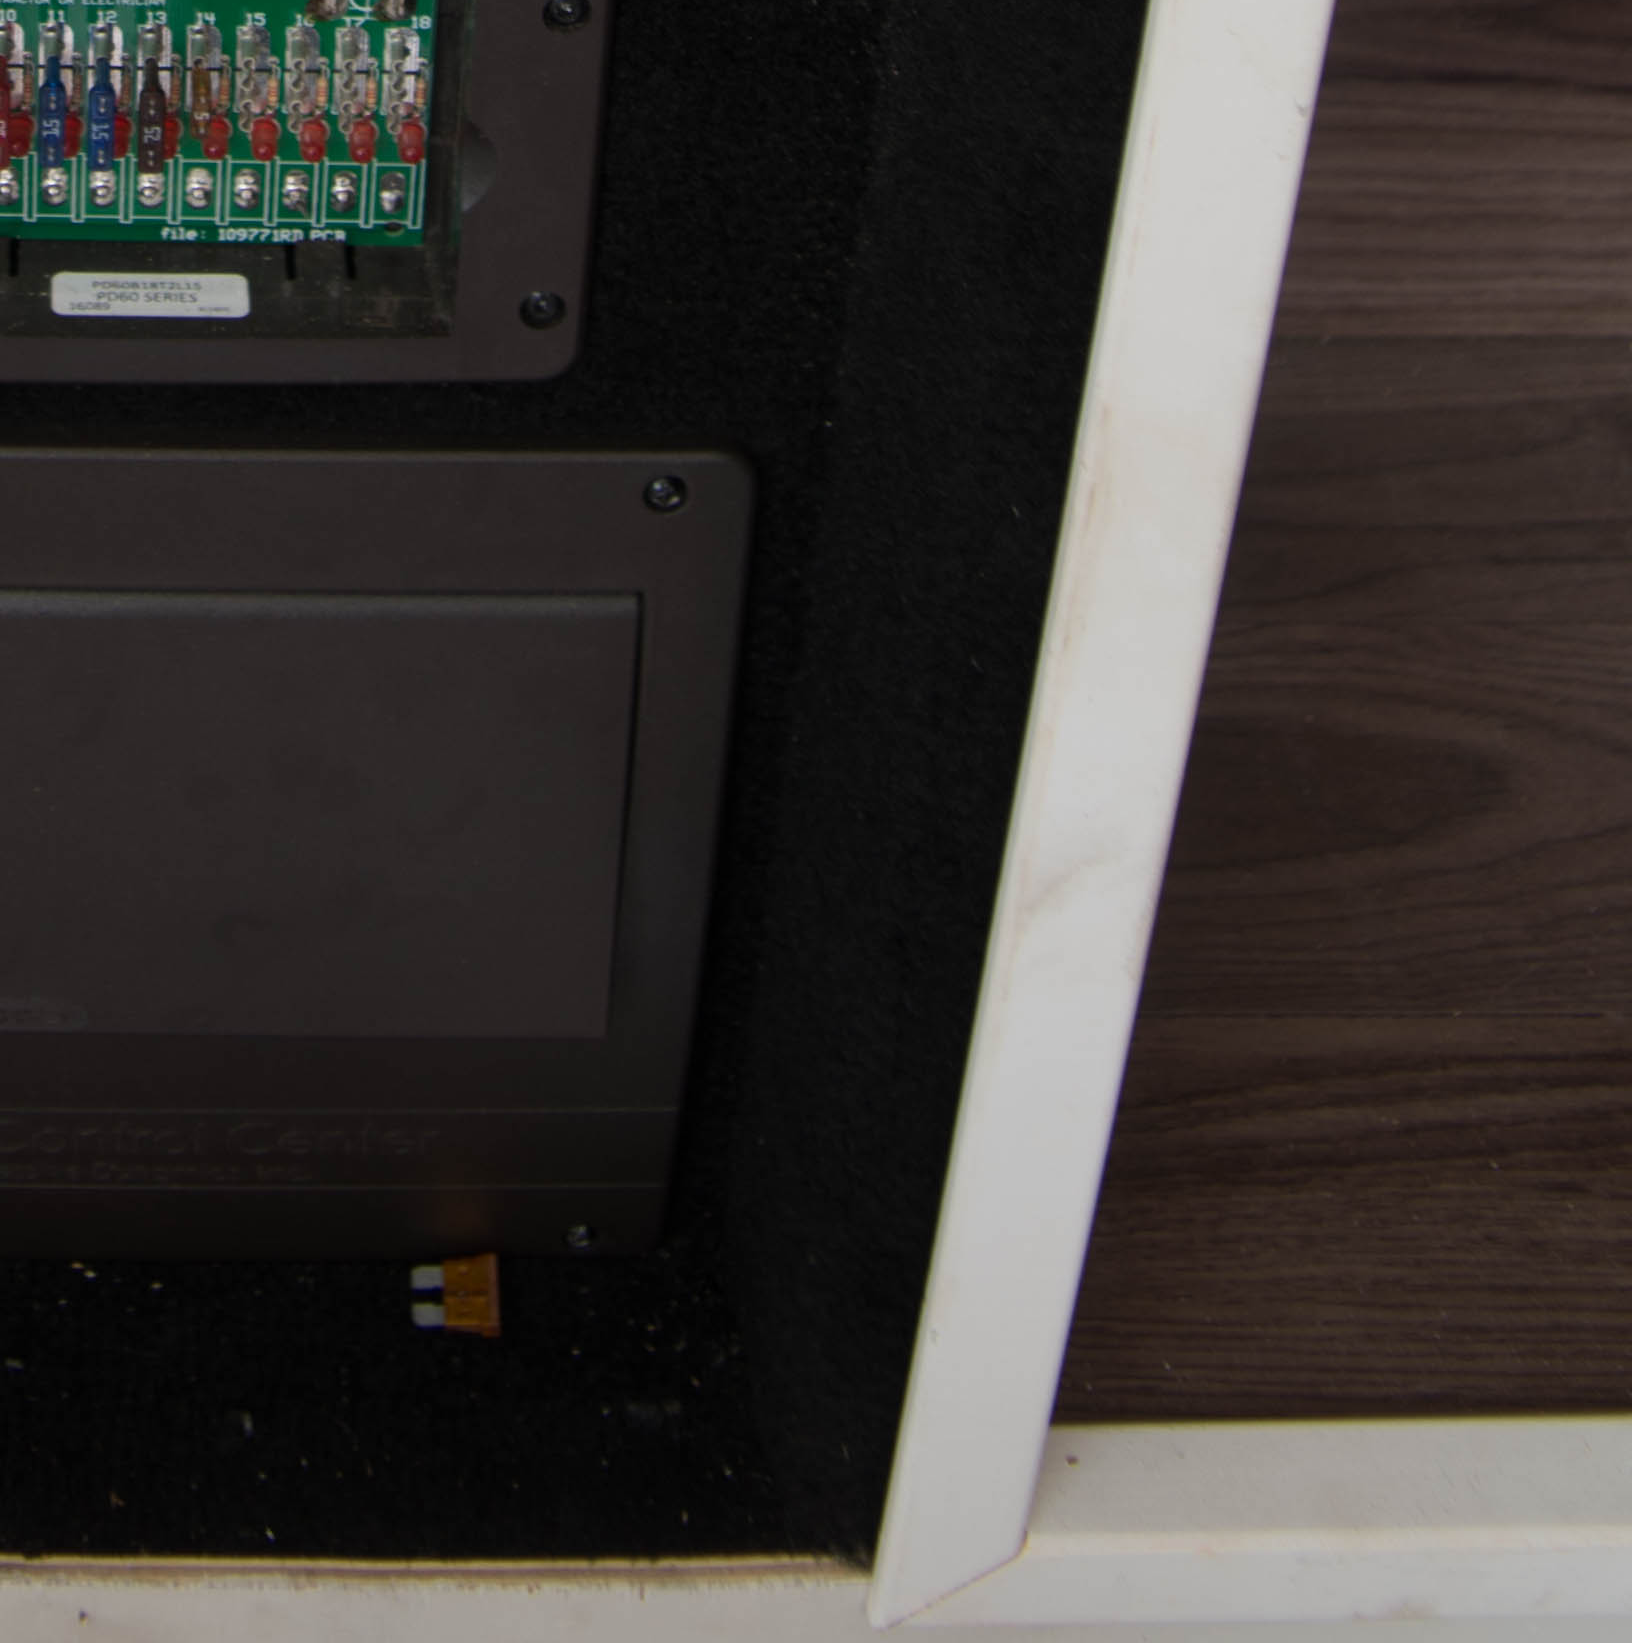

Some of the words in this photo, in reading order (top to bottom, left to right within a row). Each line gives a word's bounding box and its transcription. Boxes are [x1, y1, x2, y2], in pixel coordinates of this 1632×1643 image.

[47, 9, 66, 23] 11
[96, 9, 117, 24] 12
[147, 11, 168, 25] 13
[196, 11, 216, 26] 14
[245, 12, 267, 27] 15
[410, 15, 432, 30] 18
[42, 118, 61, 138] 15
[91, 121, 110, 140] 15
[160, 227, 207, 241] file:
[96, 292, 140, 302] PD60
[144, 292, 199, 304] SERIES
